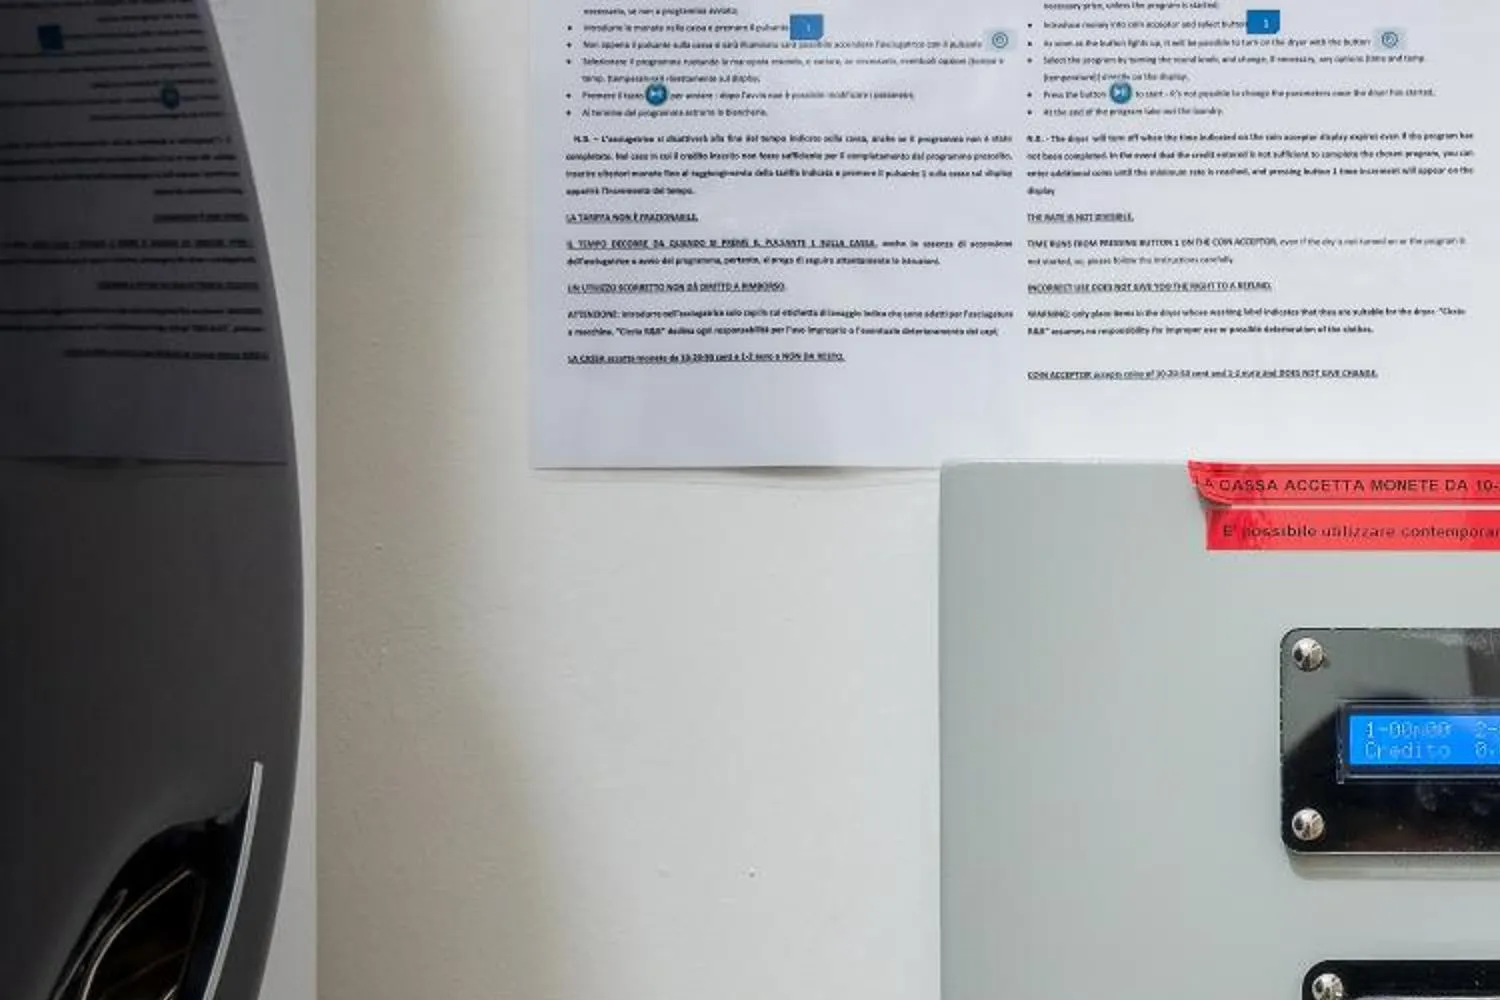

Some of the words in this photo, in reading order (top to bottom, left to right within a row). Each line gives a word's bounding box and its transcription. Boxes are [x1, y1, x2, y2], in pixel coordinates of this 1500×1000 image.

[1219, 479, 1278, 491] CASSA
[1284, 479, 1365, 492] ACCETTA
[1371, 479, 1438, 492] MONETE
[1444, 480, 1467, 492] DA
[1322, 525, 1395, 538] utilizzare
[1365, 741, 1450, 758] Credito
